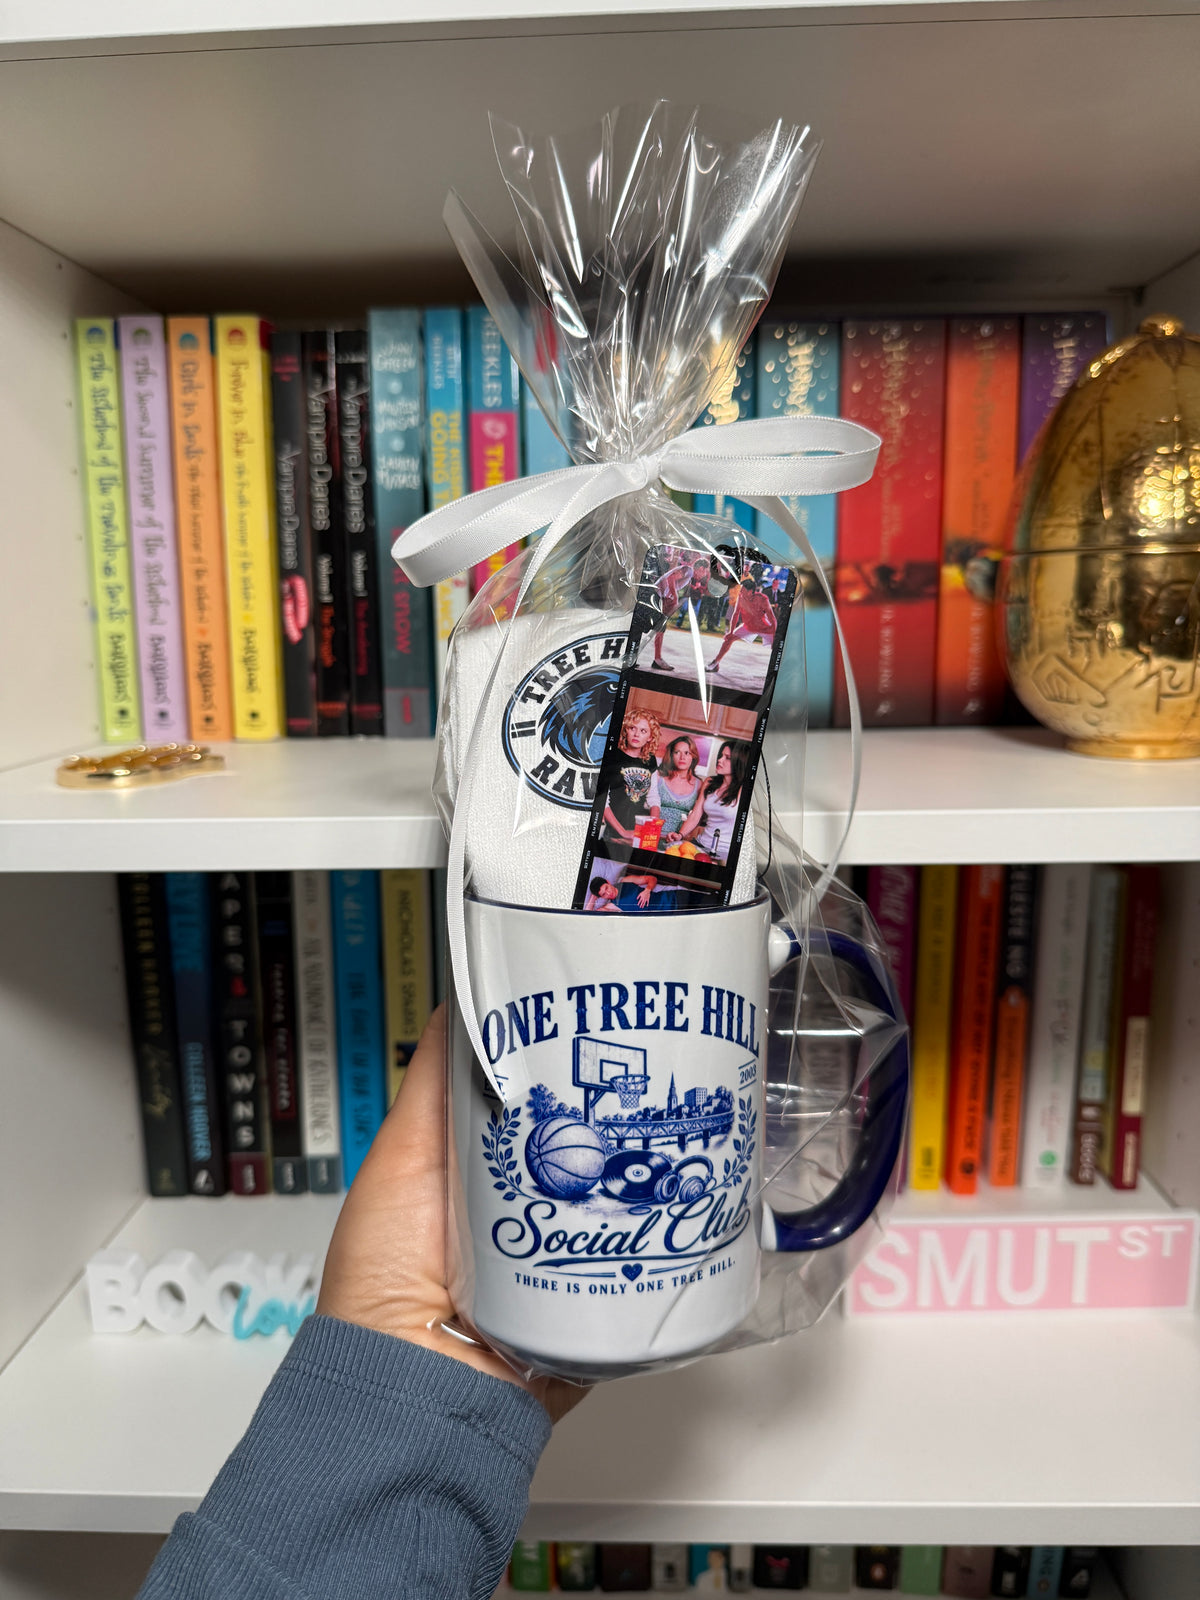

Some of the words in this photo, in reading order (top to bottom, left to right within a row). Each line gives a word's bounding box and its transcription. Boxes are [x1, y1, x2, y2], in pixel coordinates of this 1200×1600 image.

[432, 411, 449, 483] GOING
[520, 643, 591, 704] TREE
[530, 755, 600, 799] RAV
[398, 889, 416, 976] NICHOLAS
[1007, 870, 1027, 936] ELESTE
[482, 991, 558, 1065] ONE
[567, 981, 689, 1035] TREE
[700, 984, 759, 1058] HILL
[224, 1019, 256, 1149] TOWNS
[739, 1063, 757, 1084] 2003
[491, 1200, 662, 1259] Social
[664, 1177, 751, 1253] Club
[514, 1272, 559, 1291] THERE
[566, 1282, 581, 1294] IS
[588, 1283, 627, 1295] ONLY
[636, 1279, 664, 1293] ONE
[672, 1271, 704, 1288] TREE
[709, 1256, 737, 1276] HILL.
[858, 1226, 1110, 1309] SMUT
[1118, 1225, 1185, 1259] ST
